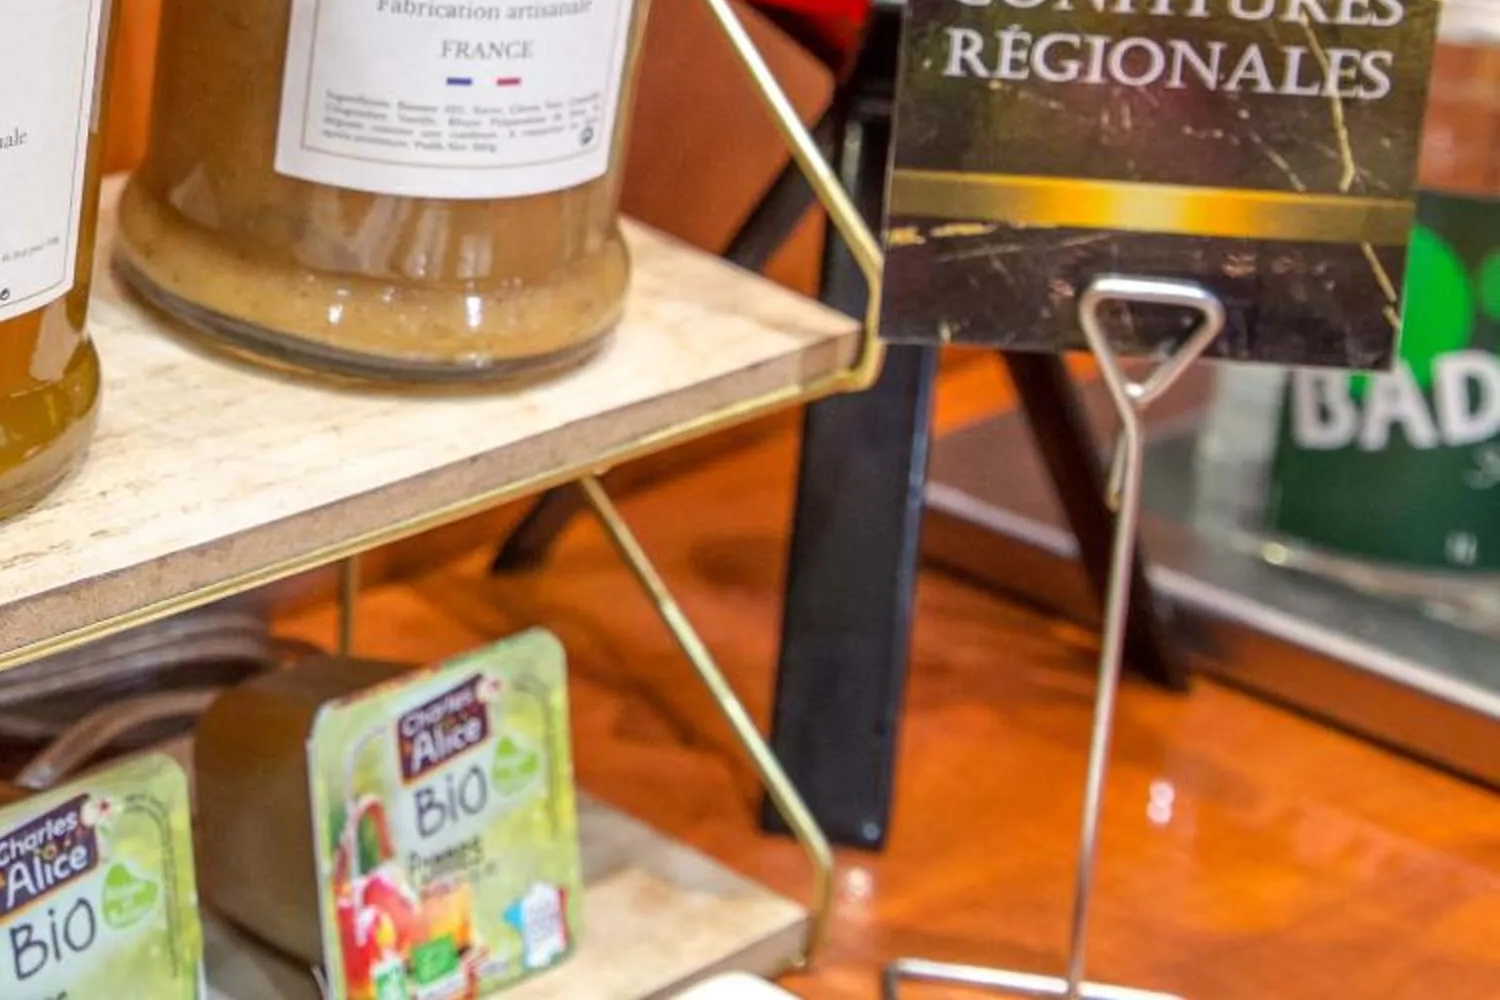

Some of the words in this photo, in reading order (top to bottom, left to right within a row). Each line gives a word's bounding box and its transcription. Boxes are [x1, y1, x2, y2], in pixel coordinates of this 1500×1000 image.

[441, 39, 534, 61] FRANCE
[941, 24, 1394, 101] RÉGIONALES
[5, 845, 89, 908] Alice
